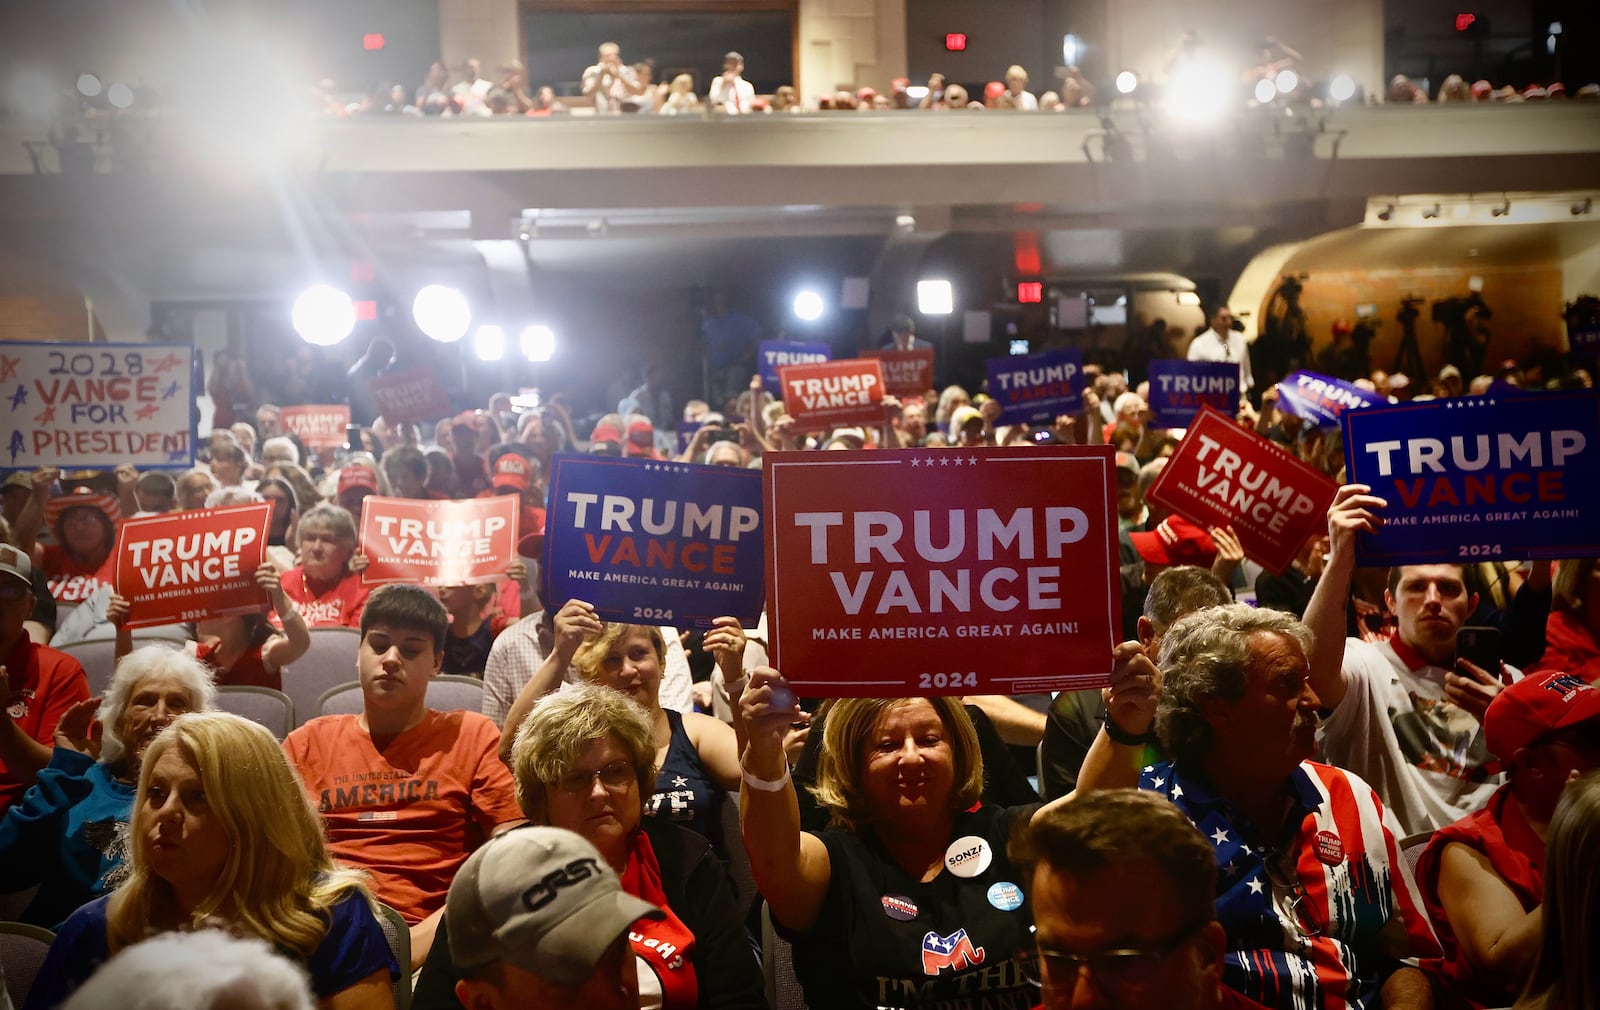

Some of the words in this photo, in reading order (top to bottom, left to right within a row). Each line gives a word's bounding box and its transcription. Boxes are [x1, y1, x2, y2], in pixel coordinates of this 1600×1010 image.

[49, 352, 144, 376] 2028
[764, 351, 828, 366] TRUMP
[789, 374, 877, 397] TRUMP
[996, 363, 1077, 390] TRUMP
[1157, 374, 1236, 395] TRUMP
[802, 389, 870, 410] VANCE
[1008, 380, 1071, 403] VANCE
[71, 404, 128, 424] FOR
[285, 414, 345, 425] TRUMP
[32, 429, 191, 457] PRESIDENT
[1365, 429, 1587, 477] TRUMP
[1196, 434, 1315, 516] TRUMP
[1196, 465, 1290, 534] VANCE
[1394, 471, 1567, 509] VANCE
[567, 491, 760, 542] TRUMP
[1199, 495, 1233, 519] AMERICA
[1383, 517, 1418, 527] MAKE
[1422, 513, 1481, 524] AMERICA
[1485, 511, 1528, 522] GREAT
[1533, 508, 1579, 520] AGAIN!
[375, 515, 506, 540] TRUMP
[794, 506, 1089, 565] TRUMP
[128, 527, 257, 567] TRUMP
[388, 537, 492, 558] VANCE
[584, 532, 738, 575] VANCE
[1459, 544, 1503, 557] 2024
[140, 554, 240, 590] VANCE
[403, 557, 440, 567] AMERICA
[568, 569, 600, 581] MAKE
[604, 573, 658, 586] AMERICA
[662, 578, 701, 589] GREAT
[704, 581, 744, 592] AGAIN!
[829, 566, 1062, 616] VANCE
[133, 593, 155, 603] MAKE
[157, 589, 192, 601] AMERICA
[194, 585, 219, 595] GREAT
[181, 608, 208, 620] 2024
[633, 606, 674, 621] 2024
[812, 627, 862, 640] MAKE
[868, 626, 950, 640] AMERICA
[955, 624, 1014, 638] GREAT
[1020, 622, 1079, 636] AGAIN!
[919, 671, 978, 689] 2024
[319, 779, 440, 812] AMERICA
[1317, 835, 1342, 847] TRUMP
[1319, 846, 1341, 858] VANCE
[948, 844, 986, 866] SONZA
[522, 857, 603, 912] CRST
[992, 885, 1018, 895] TRUMP
